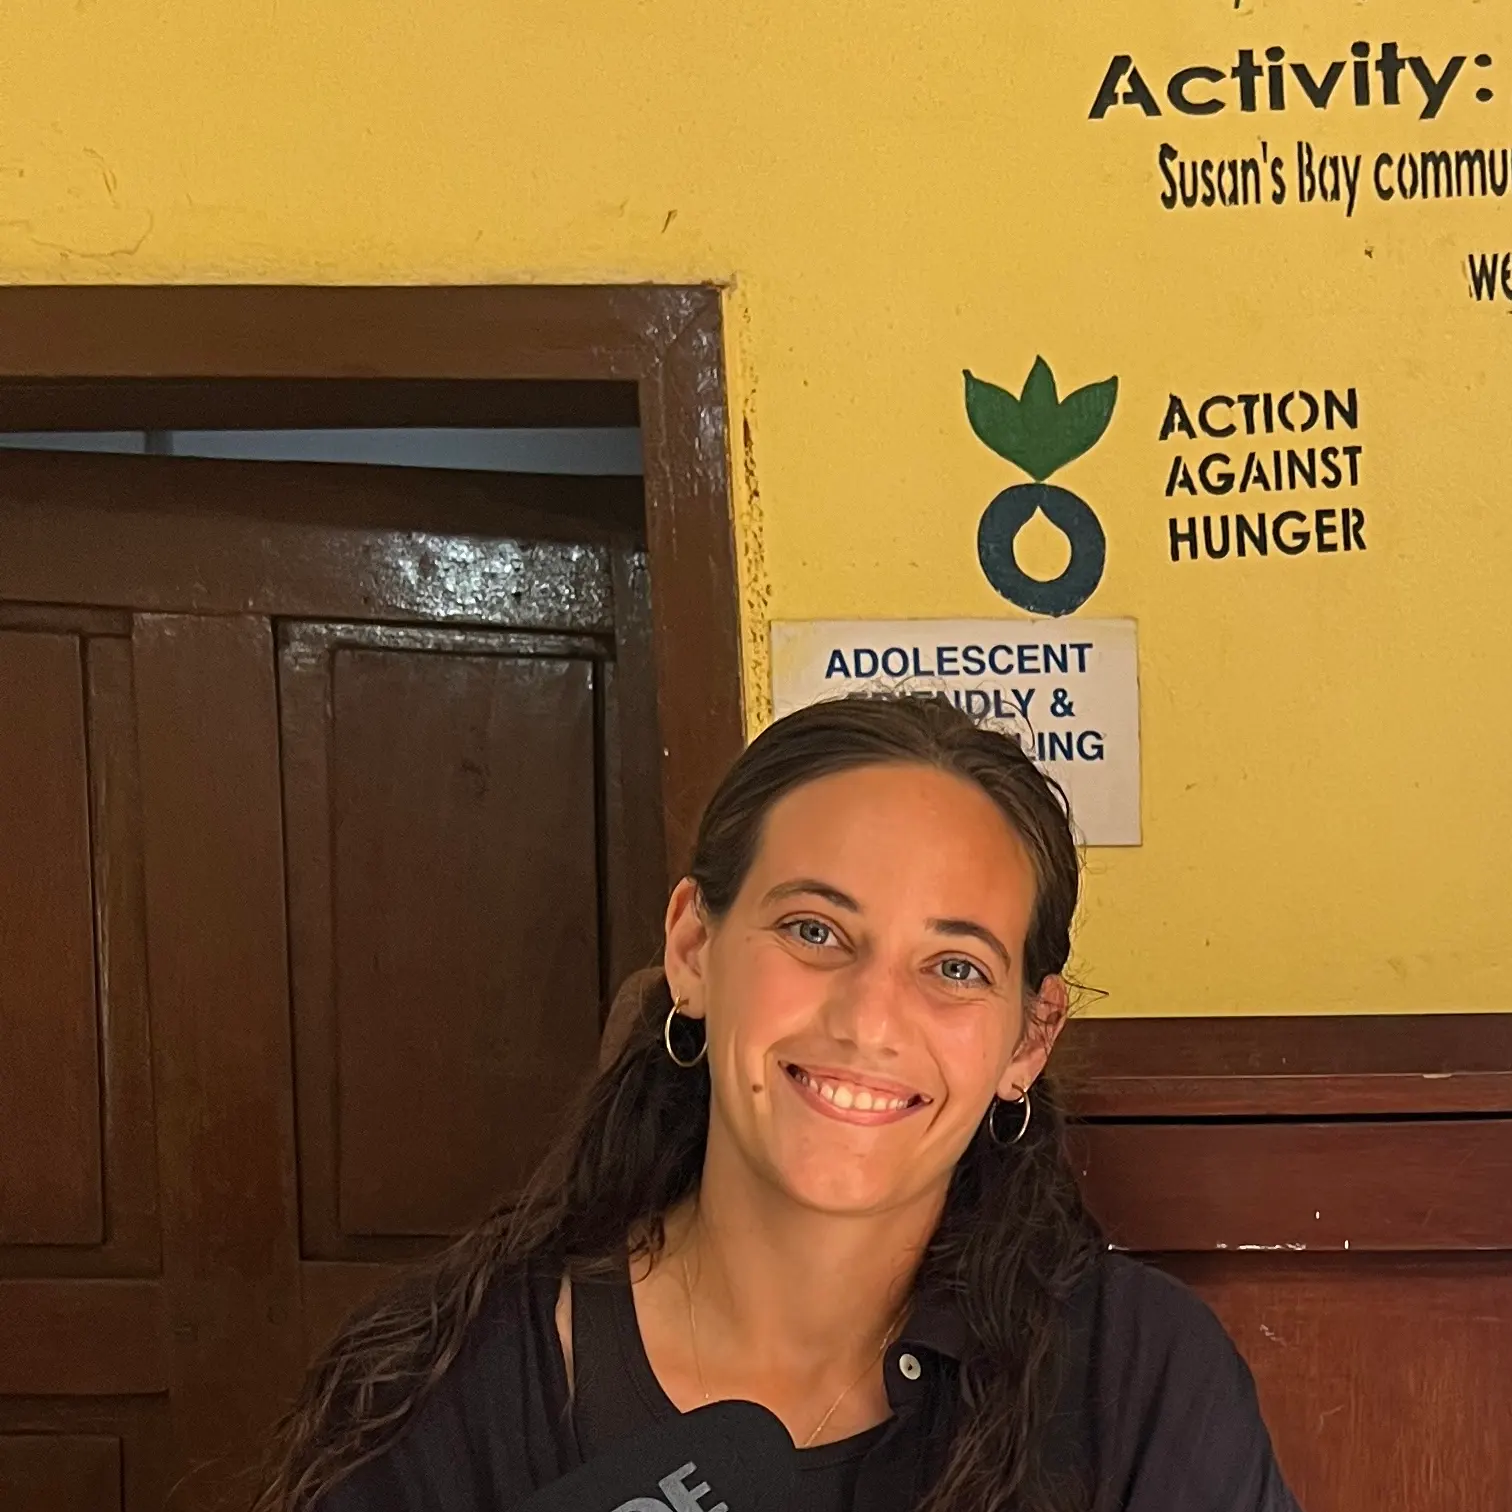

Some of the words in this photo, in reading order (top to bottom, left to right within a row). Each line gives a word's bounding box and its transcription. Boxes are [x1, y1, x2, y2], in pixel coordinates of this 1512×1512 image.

[1088, 41, 1493, 120] Activity:
[1158, 141, 1286, 209] Susan's
[1297, 141, 1361, 217] Bay
[1159, 388, 1357, 441] ACTION
[1165, 446, 1362, 497] AGAINST
[1169, 508, 1366, 562] HUNGER
[825, 643, 1093, 679] ADOLESCENT
[1050, 688, 1075, 717] &
